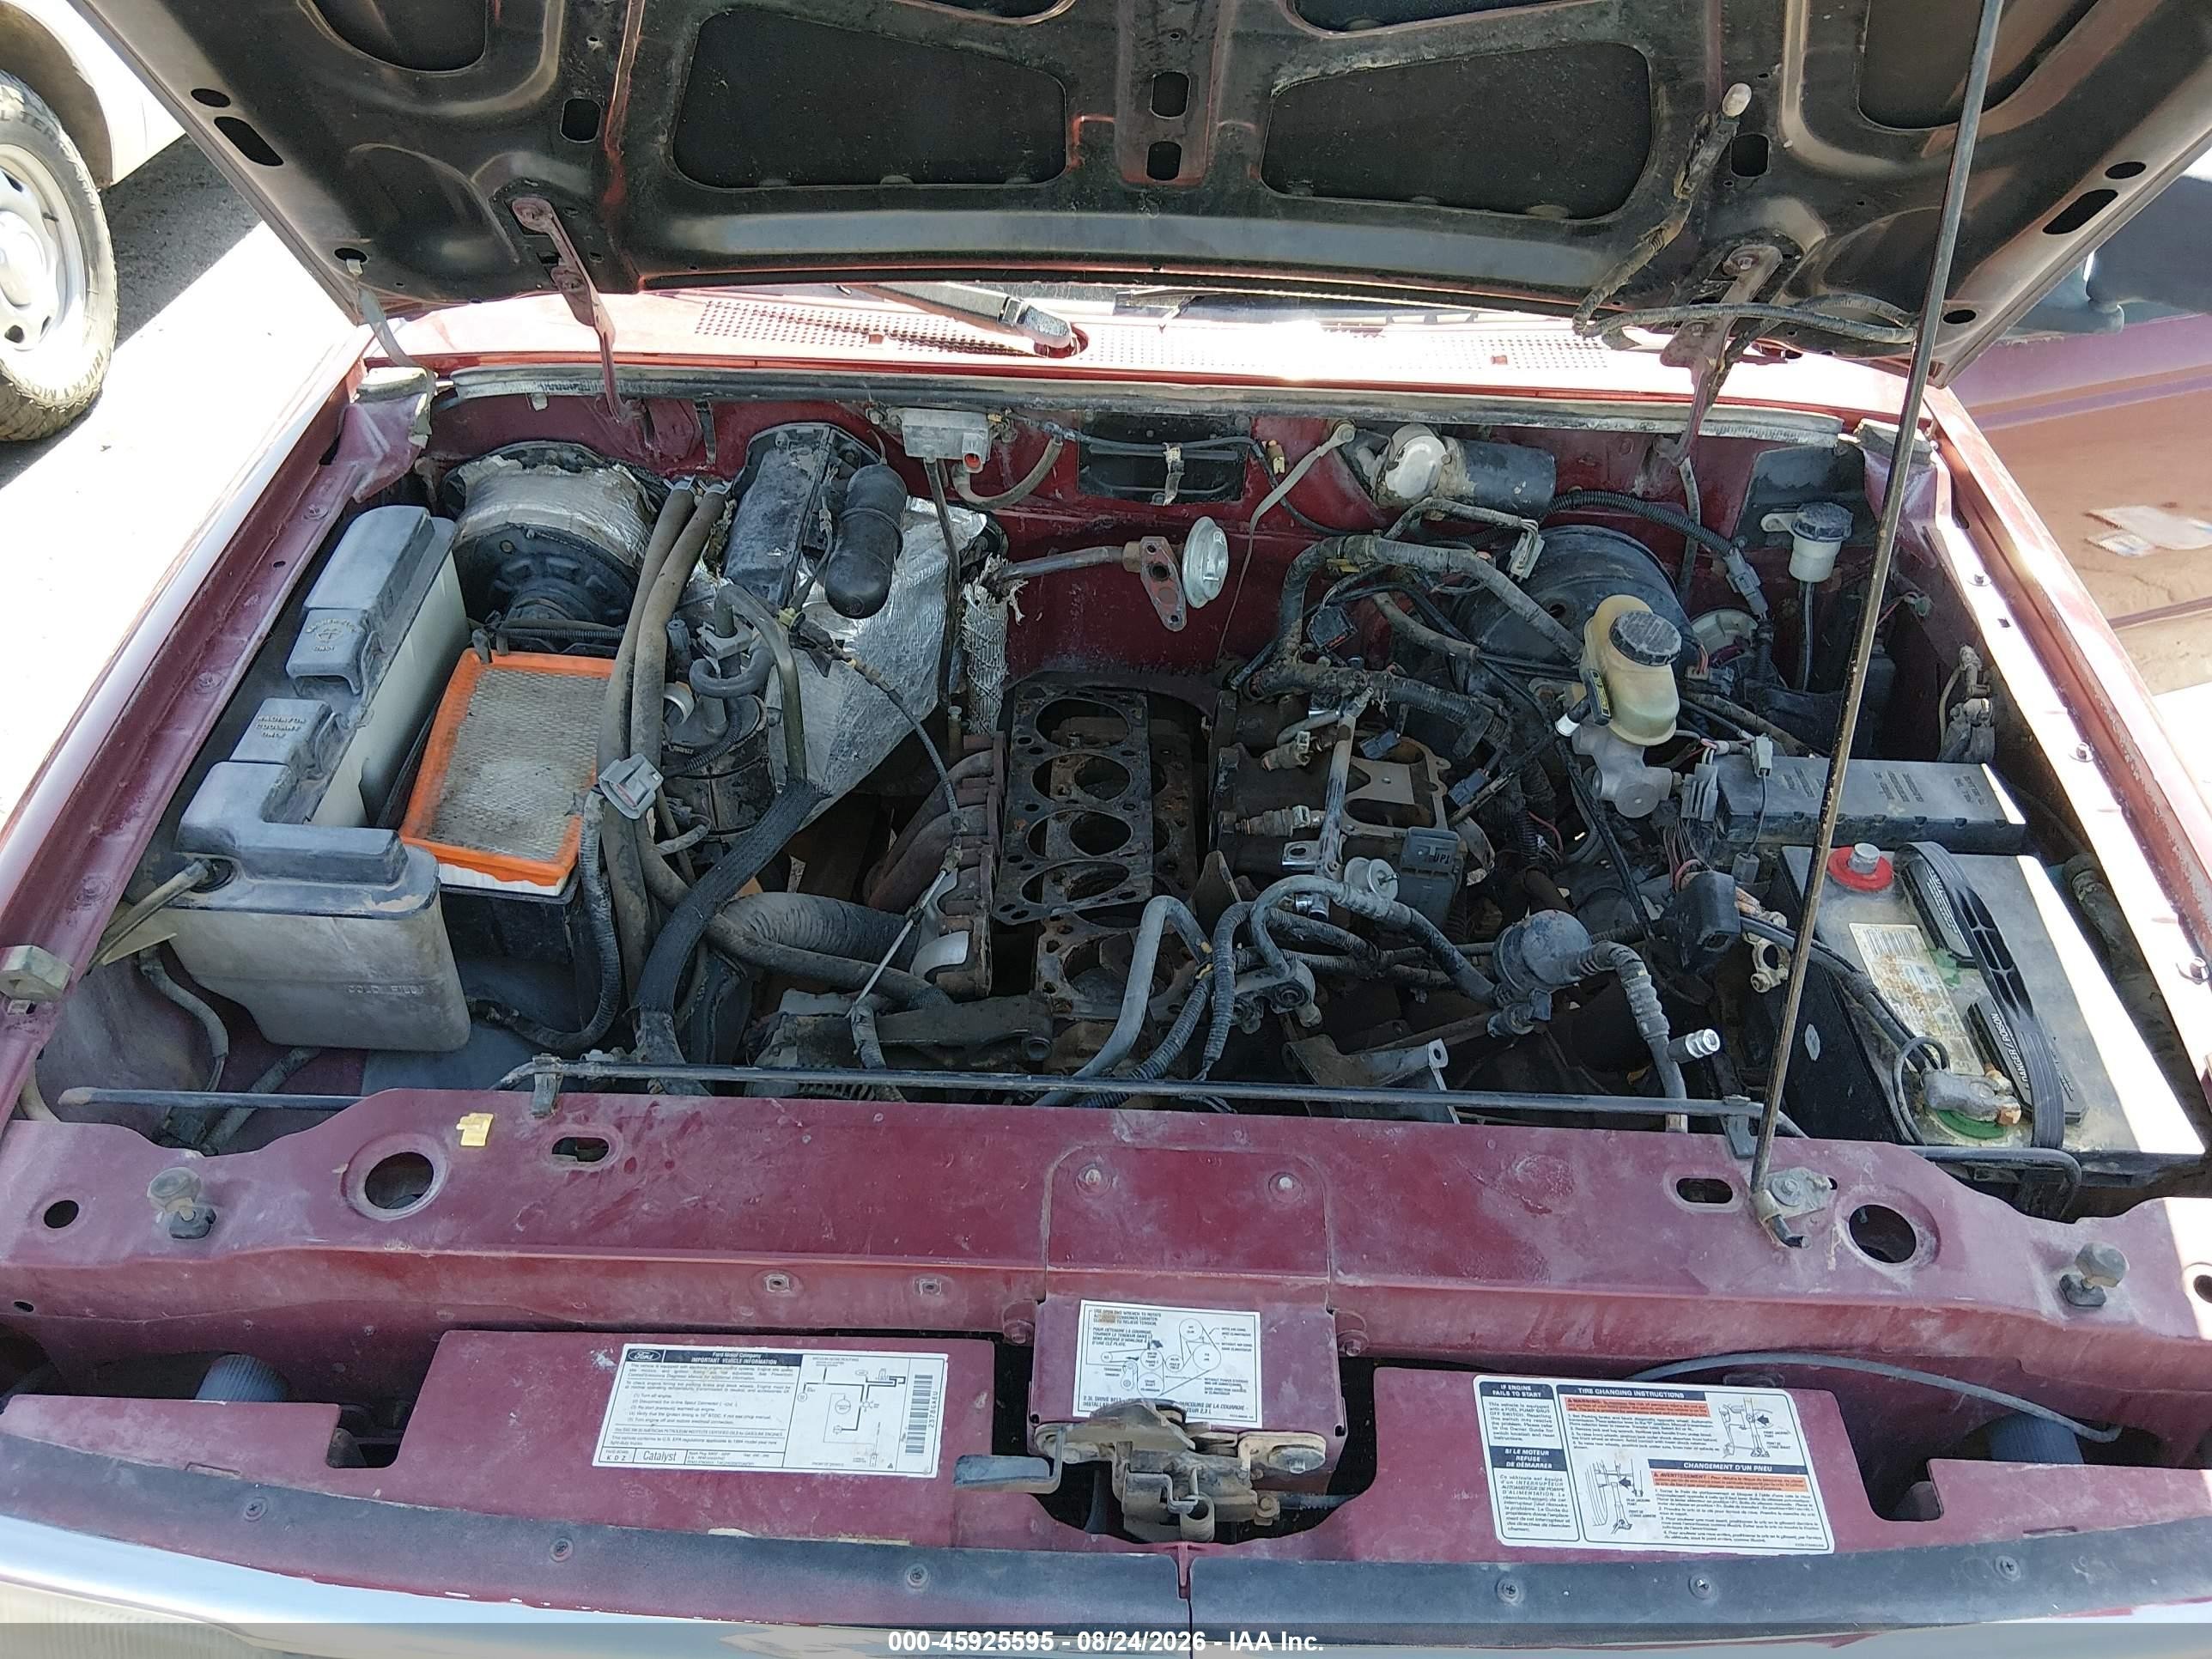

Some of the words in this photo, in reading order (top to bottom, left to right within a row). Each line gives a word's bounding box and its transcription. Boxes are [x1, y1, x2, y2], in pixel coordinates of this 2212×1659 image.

[634, 1351, 654, 1359] Ford
[641, 1450, 677, 1462] Catalyst
[1682, 1462, 1733, 1470] CHANGEMENT
